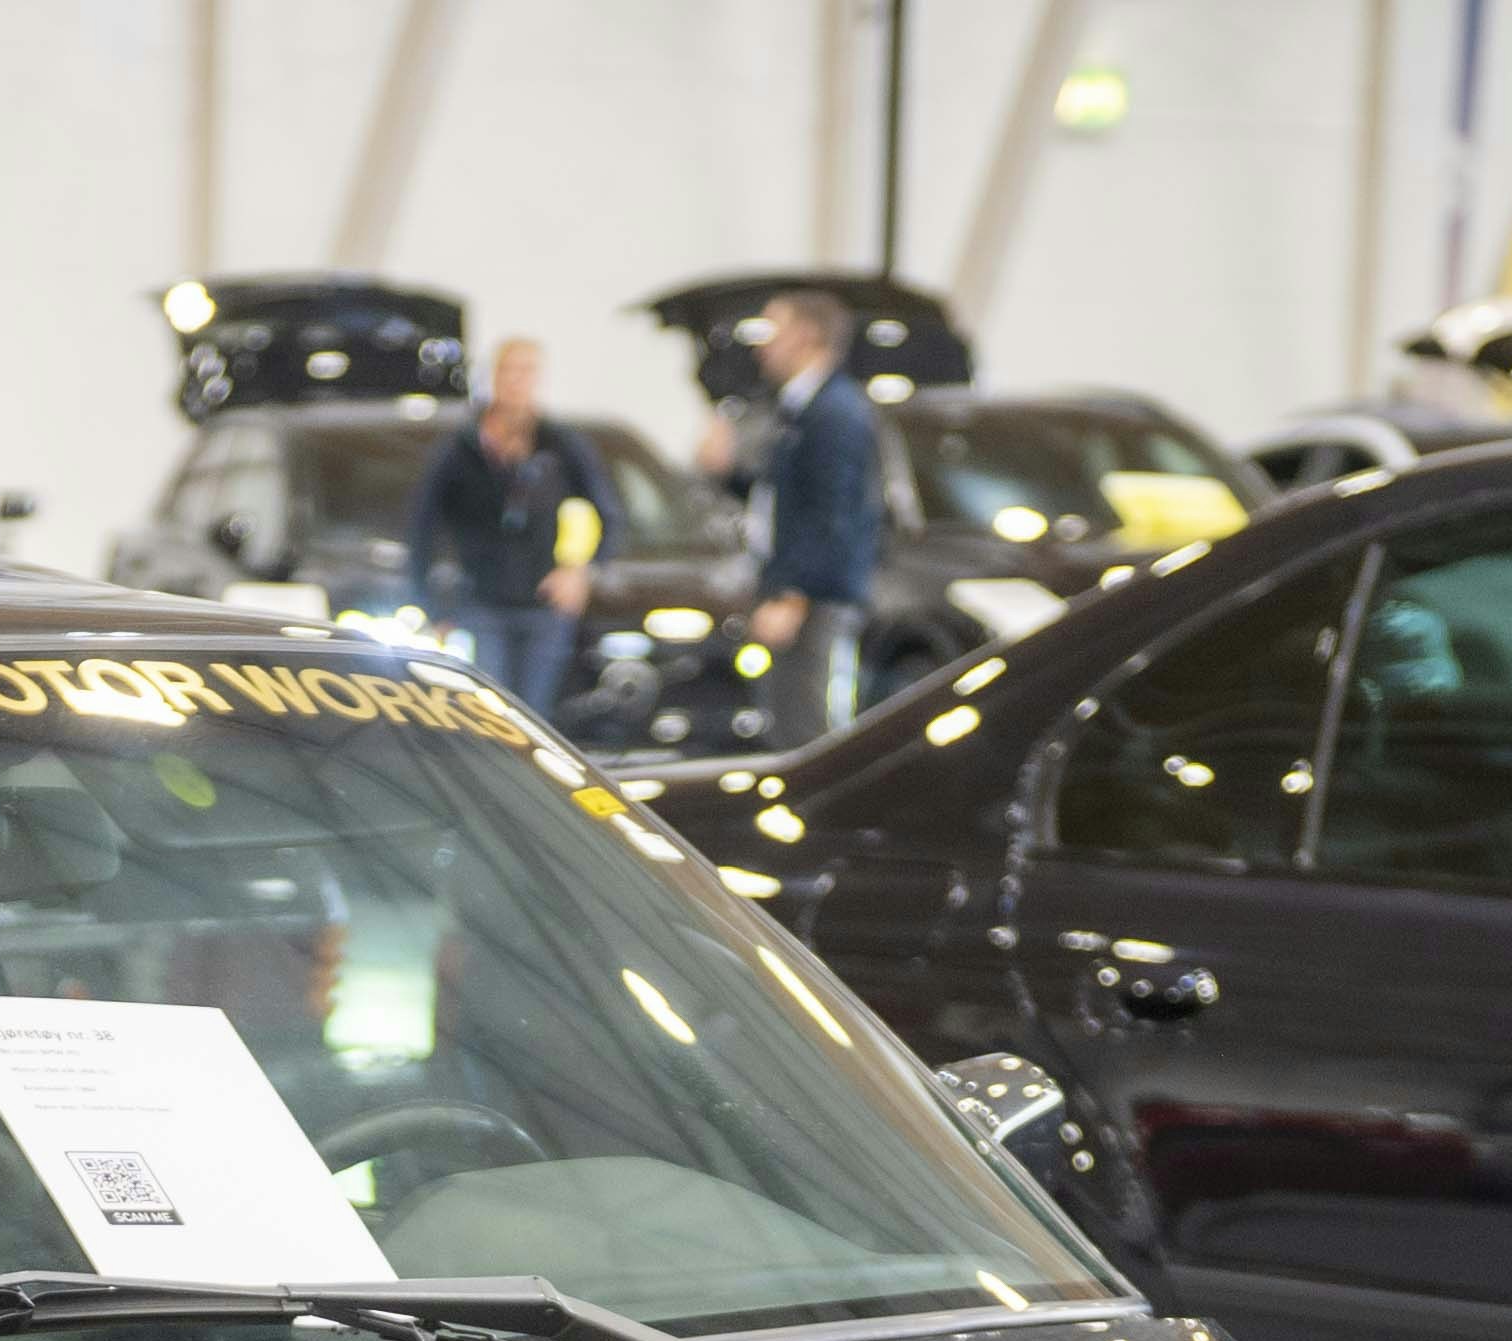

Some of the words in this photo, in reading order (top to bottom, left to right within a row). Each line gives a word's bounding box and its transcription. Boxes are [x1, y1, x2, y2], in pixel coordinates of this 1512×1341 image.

[210, 662, 530, 748] WORKS
[112, 1211, 150, 1225] SCAN
[153, 1211, 175, 1225] ME
